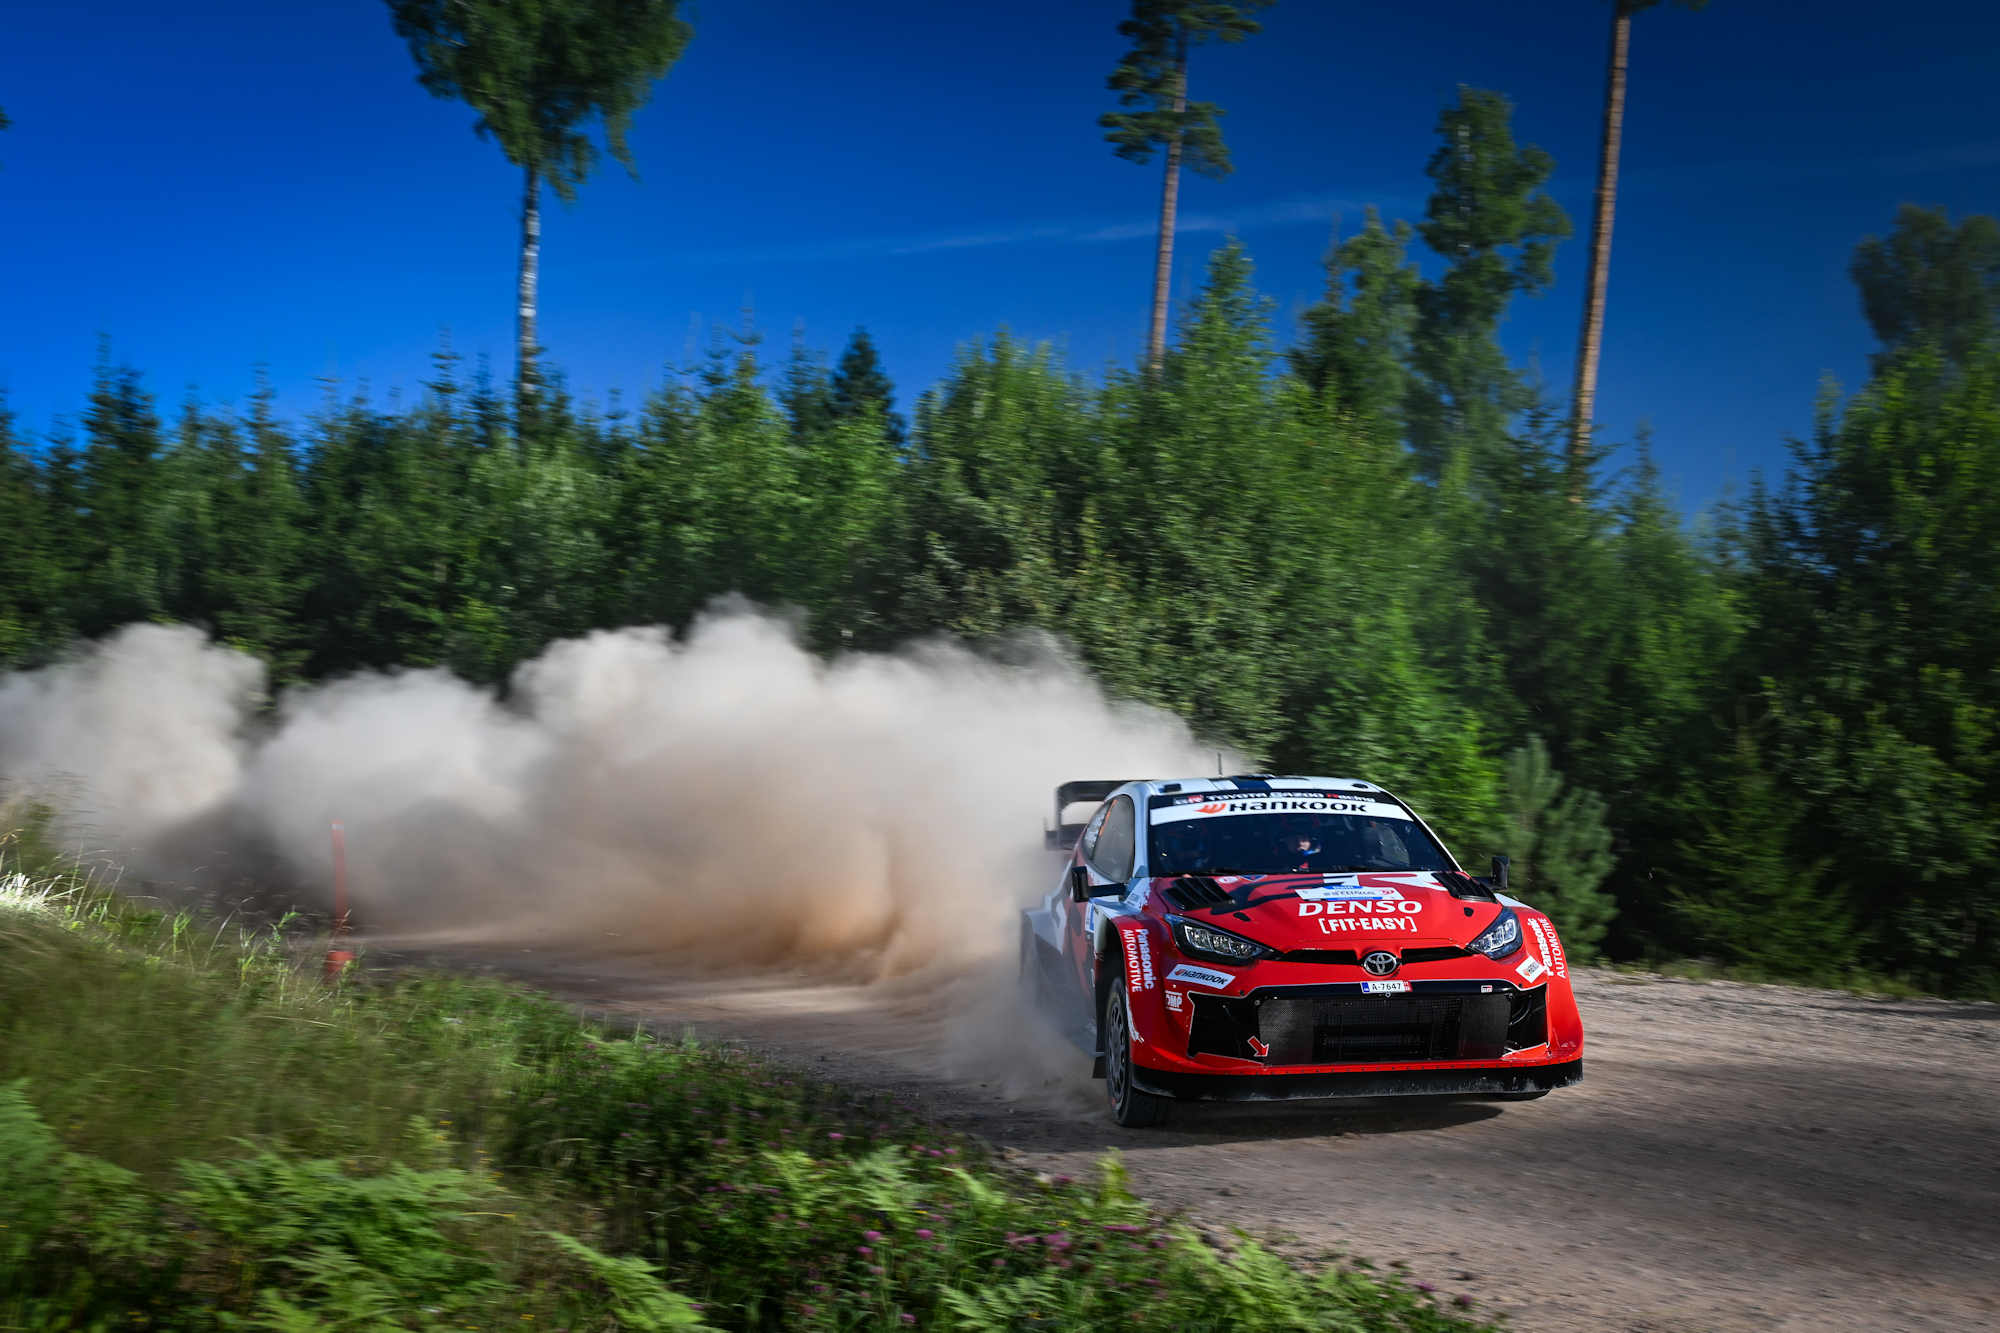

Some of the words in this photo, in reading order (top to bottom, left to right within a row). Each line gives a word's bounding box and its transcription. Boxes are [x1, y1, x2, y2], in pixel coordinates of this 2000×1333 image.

[1298, 900, 1423, 917] DENSO
[1122, 929, 1143, 993] AUTOMOTIVE
[1135, 928, 1157, 990] Panasonic
[1372, 982, 1402, 991] A-7647
